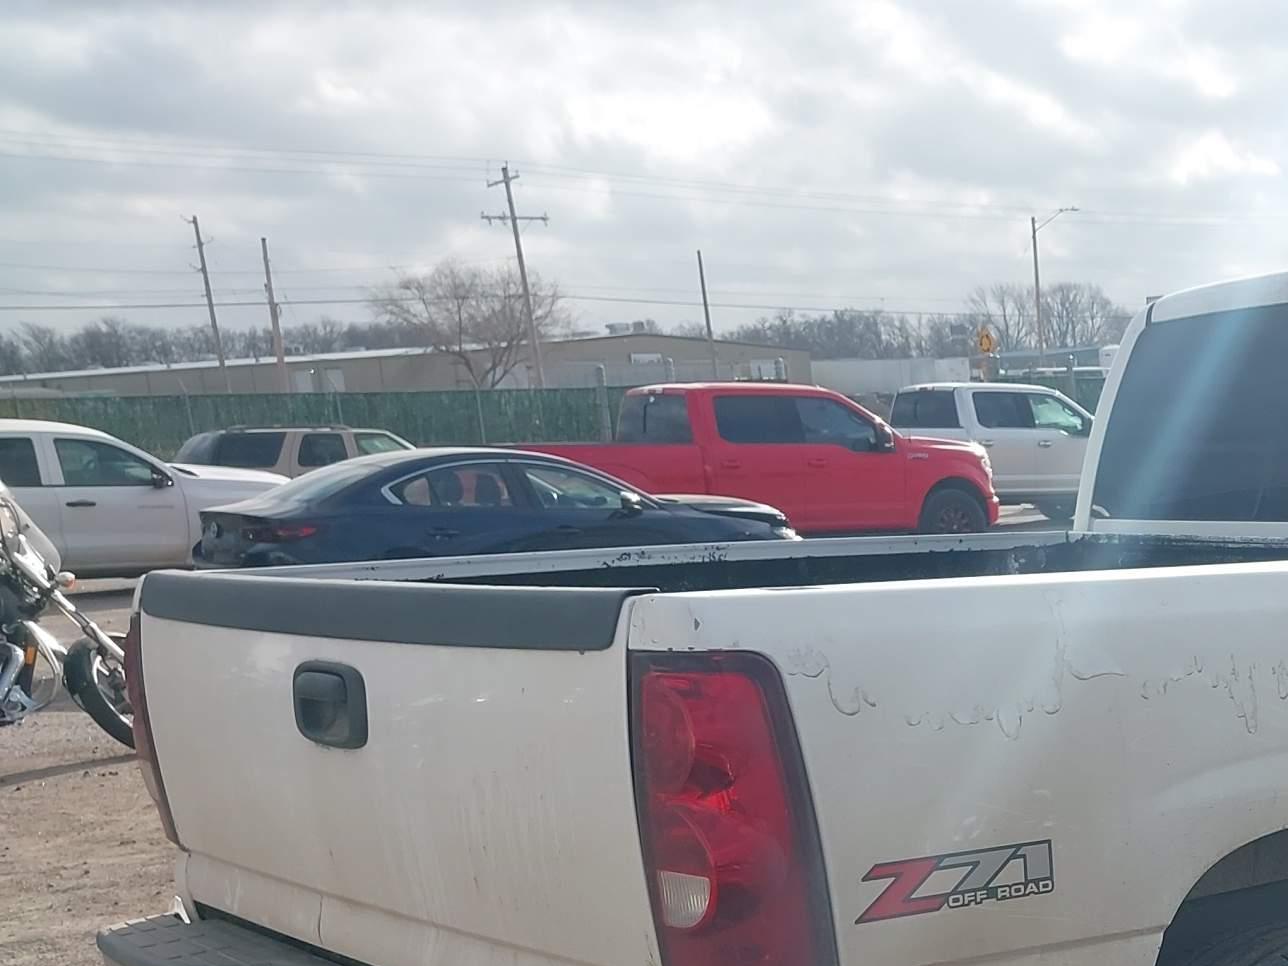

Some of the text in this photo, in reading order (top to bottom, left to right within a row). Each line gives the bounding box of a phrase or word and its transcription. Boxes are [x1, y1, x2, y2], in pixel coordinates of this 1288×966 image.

[855, 839, 1053, 925] Z71
[948, 879, 1054, 909] OFF ROAD
